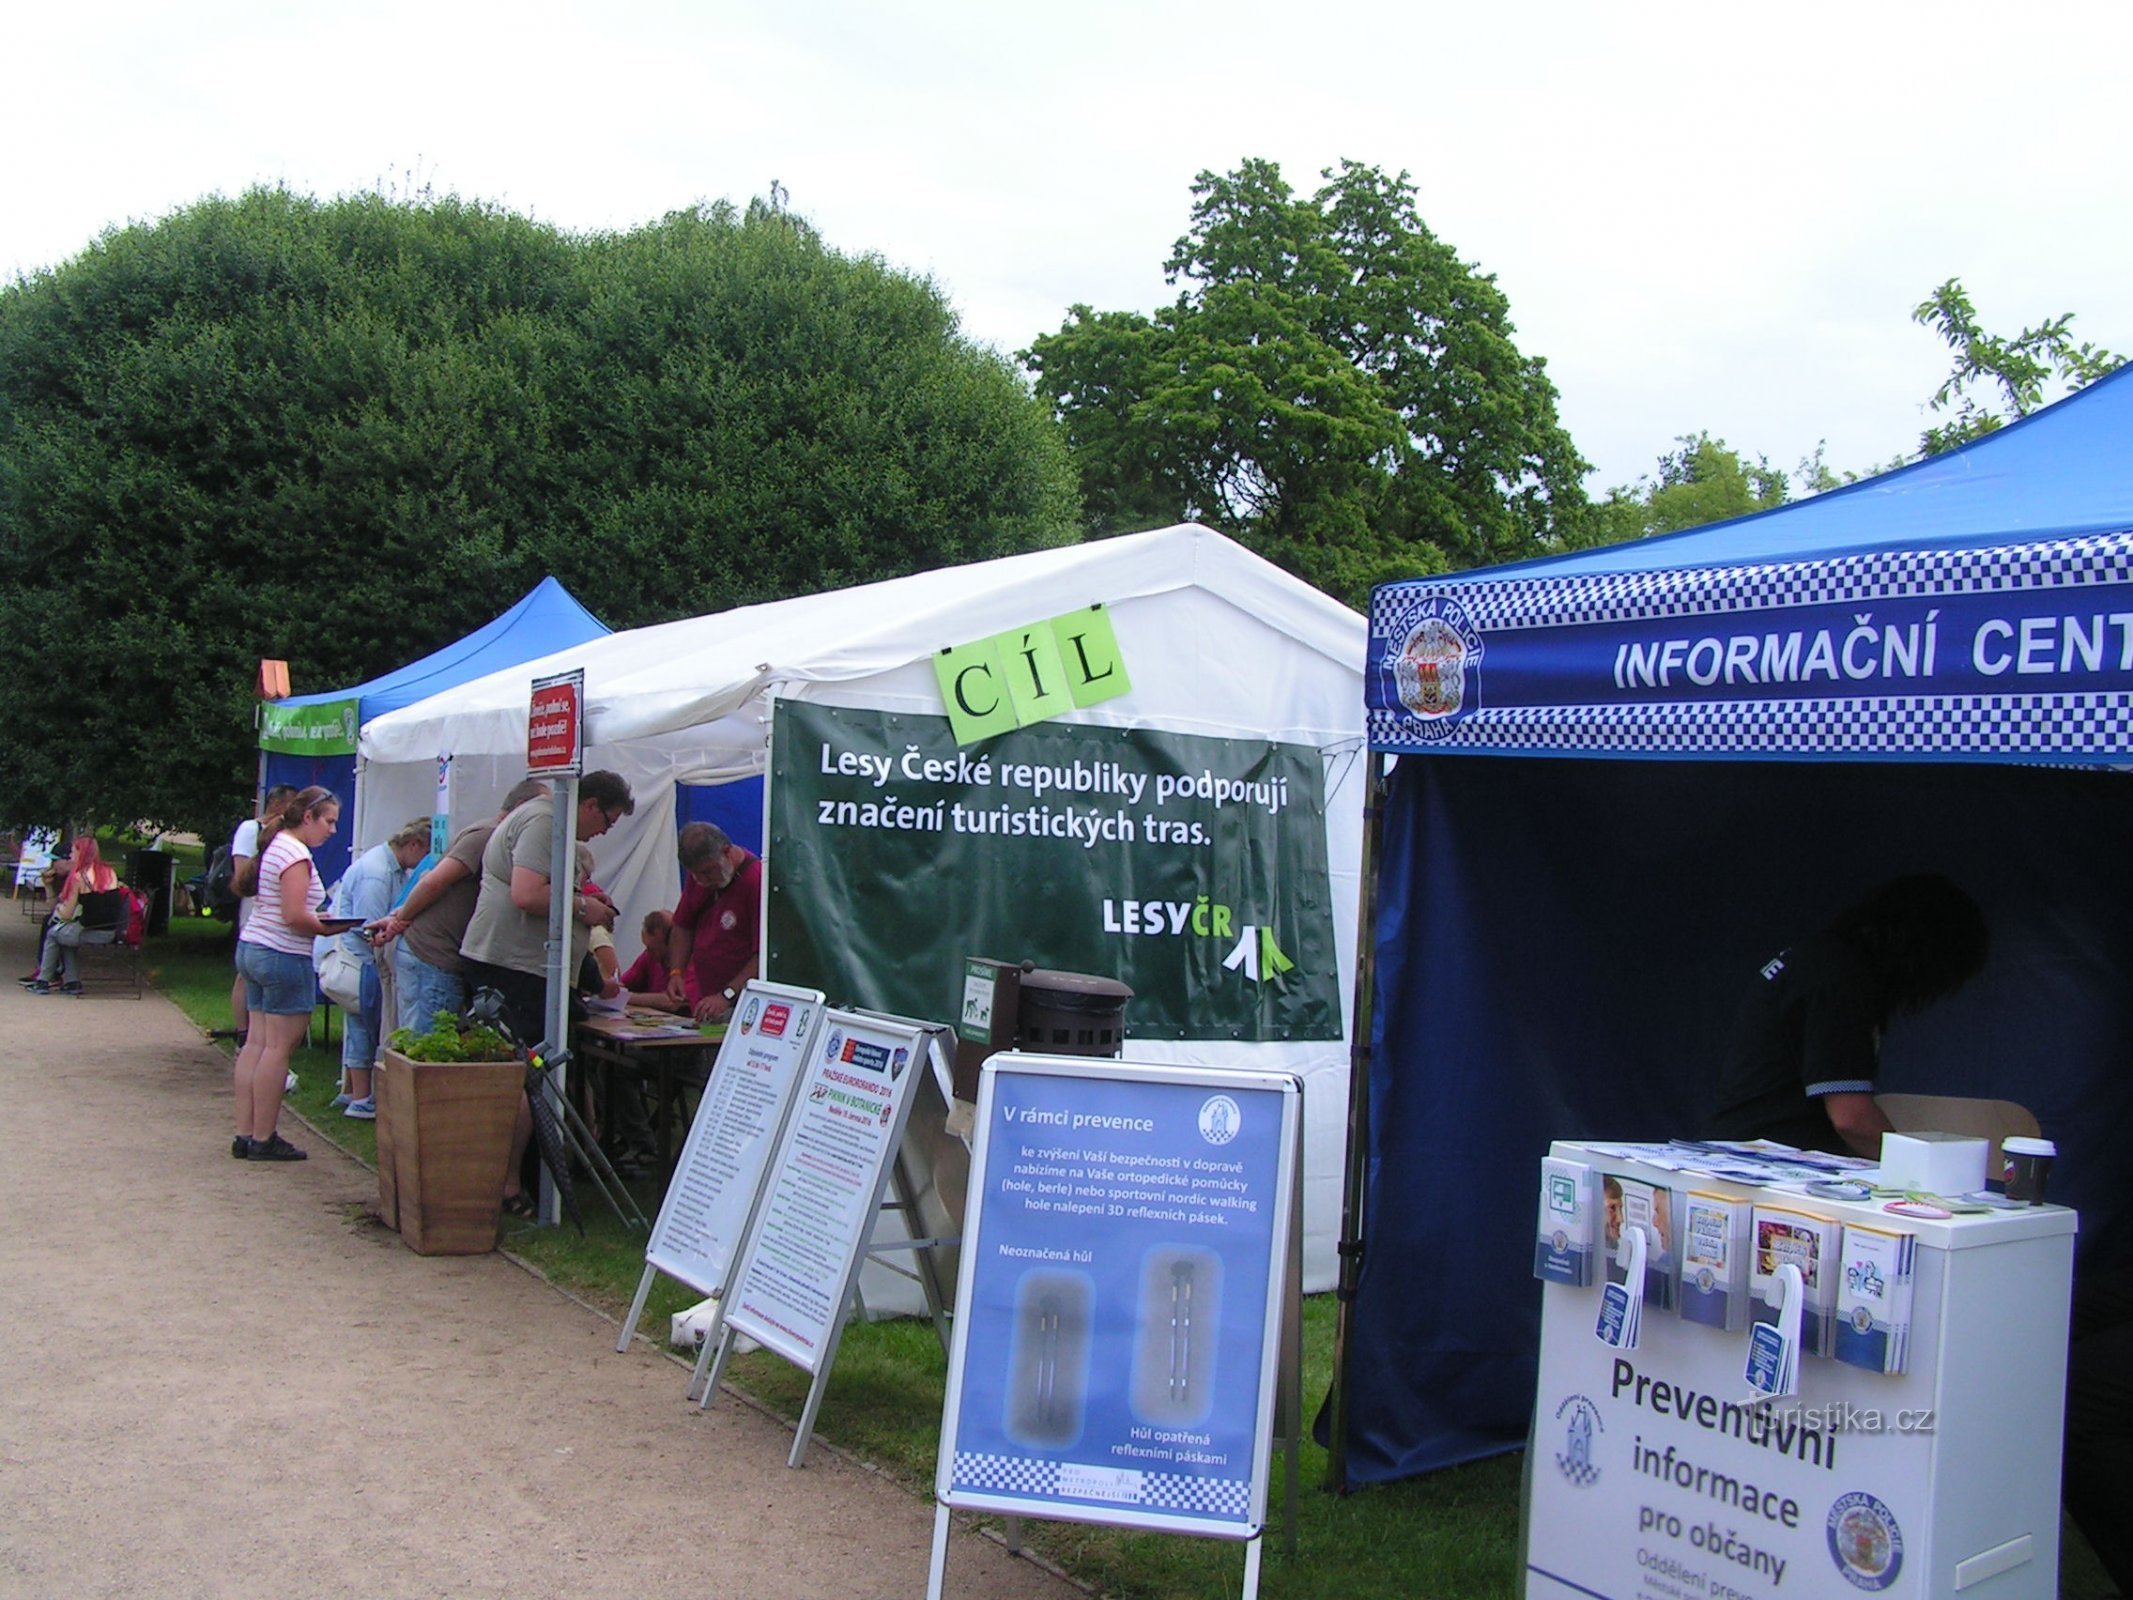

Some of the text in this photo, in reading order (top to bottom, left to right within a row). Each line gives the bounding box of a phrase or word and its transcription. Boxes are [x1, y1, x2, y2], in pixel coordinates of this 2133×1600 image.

[1441, 601, 1482, 669] POLICIE
[1614, 609, 1939, 688] INFORMAČNÍ
[955, 633, 1113, 717] CÍL
[1402, 716, 1454, 740] PRAHA
[821, 743, 1288, 814] Lesy České republiky podporují
[818, 795, 1211, 848] značení turistických tras.
[1004, 1106, 1153, 1132] V rámci prevence
[1014, 1163, 1248, 1194] nabízíme na Vaše ortopedické pomůcky
[1021, 1145, 1244, 1174] ke zvýšení Vaší bezpečnosti v dopravě
[1002, 1178, 1258, 1213] (hole, berle) nebo sportovní nordic walking
[1025, 1197, 1229, 1225] hole nalepení 3D reflexních pásek.
[999, 1244, 1093, 1263] Neoznačená hůl
[1612, 1357, 1838, 1470] Preventivní
[1111, 1443, 1227, 1466] reflexními páskami
[1130, 1426, 1211, 1446] Hůl opatřená
[1633, 1435, 1799, 1529] informace
[1639, 1504, 1786, 1586] pro občany
[1636, 1548, 1708, 1590] Oddělení
